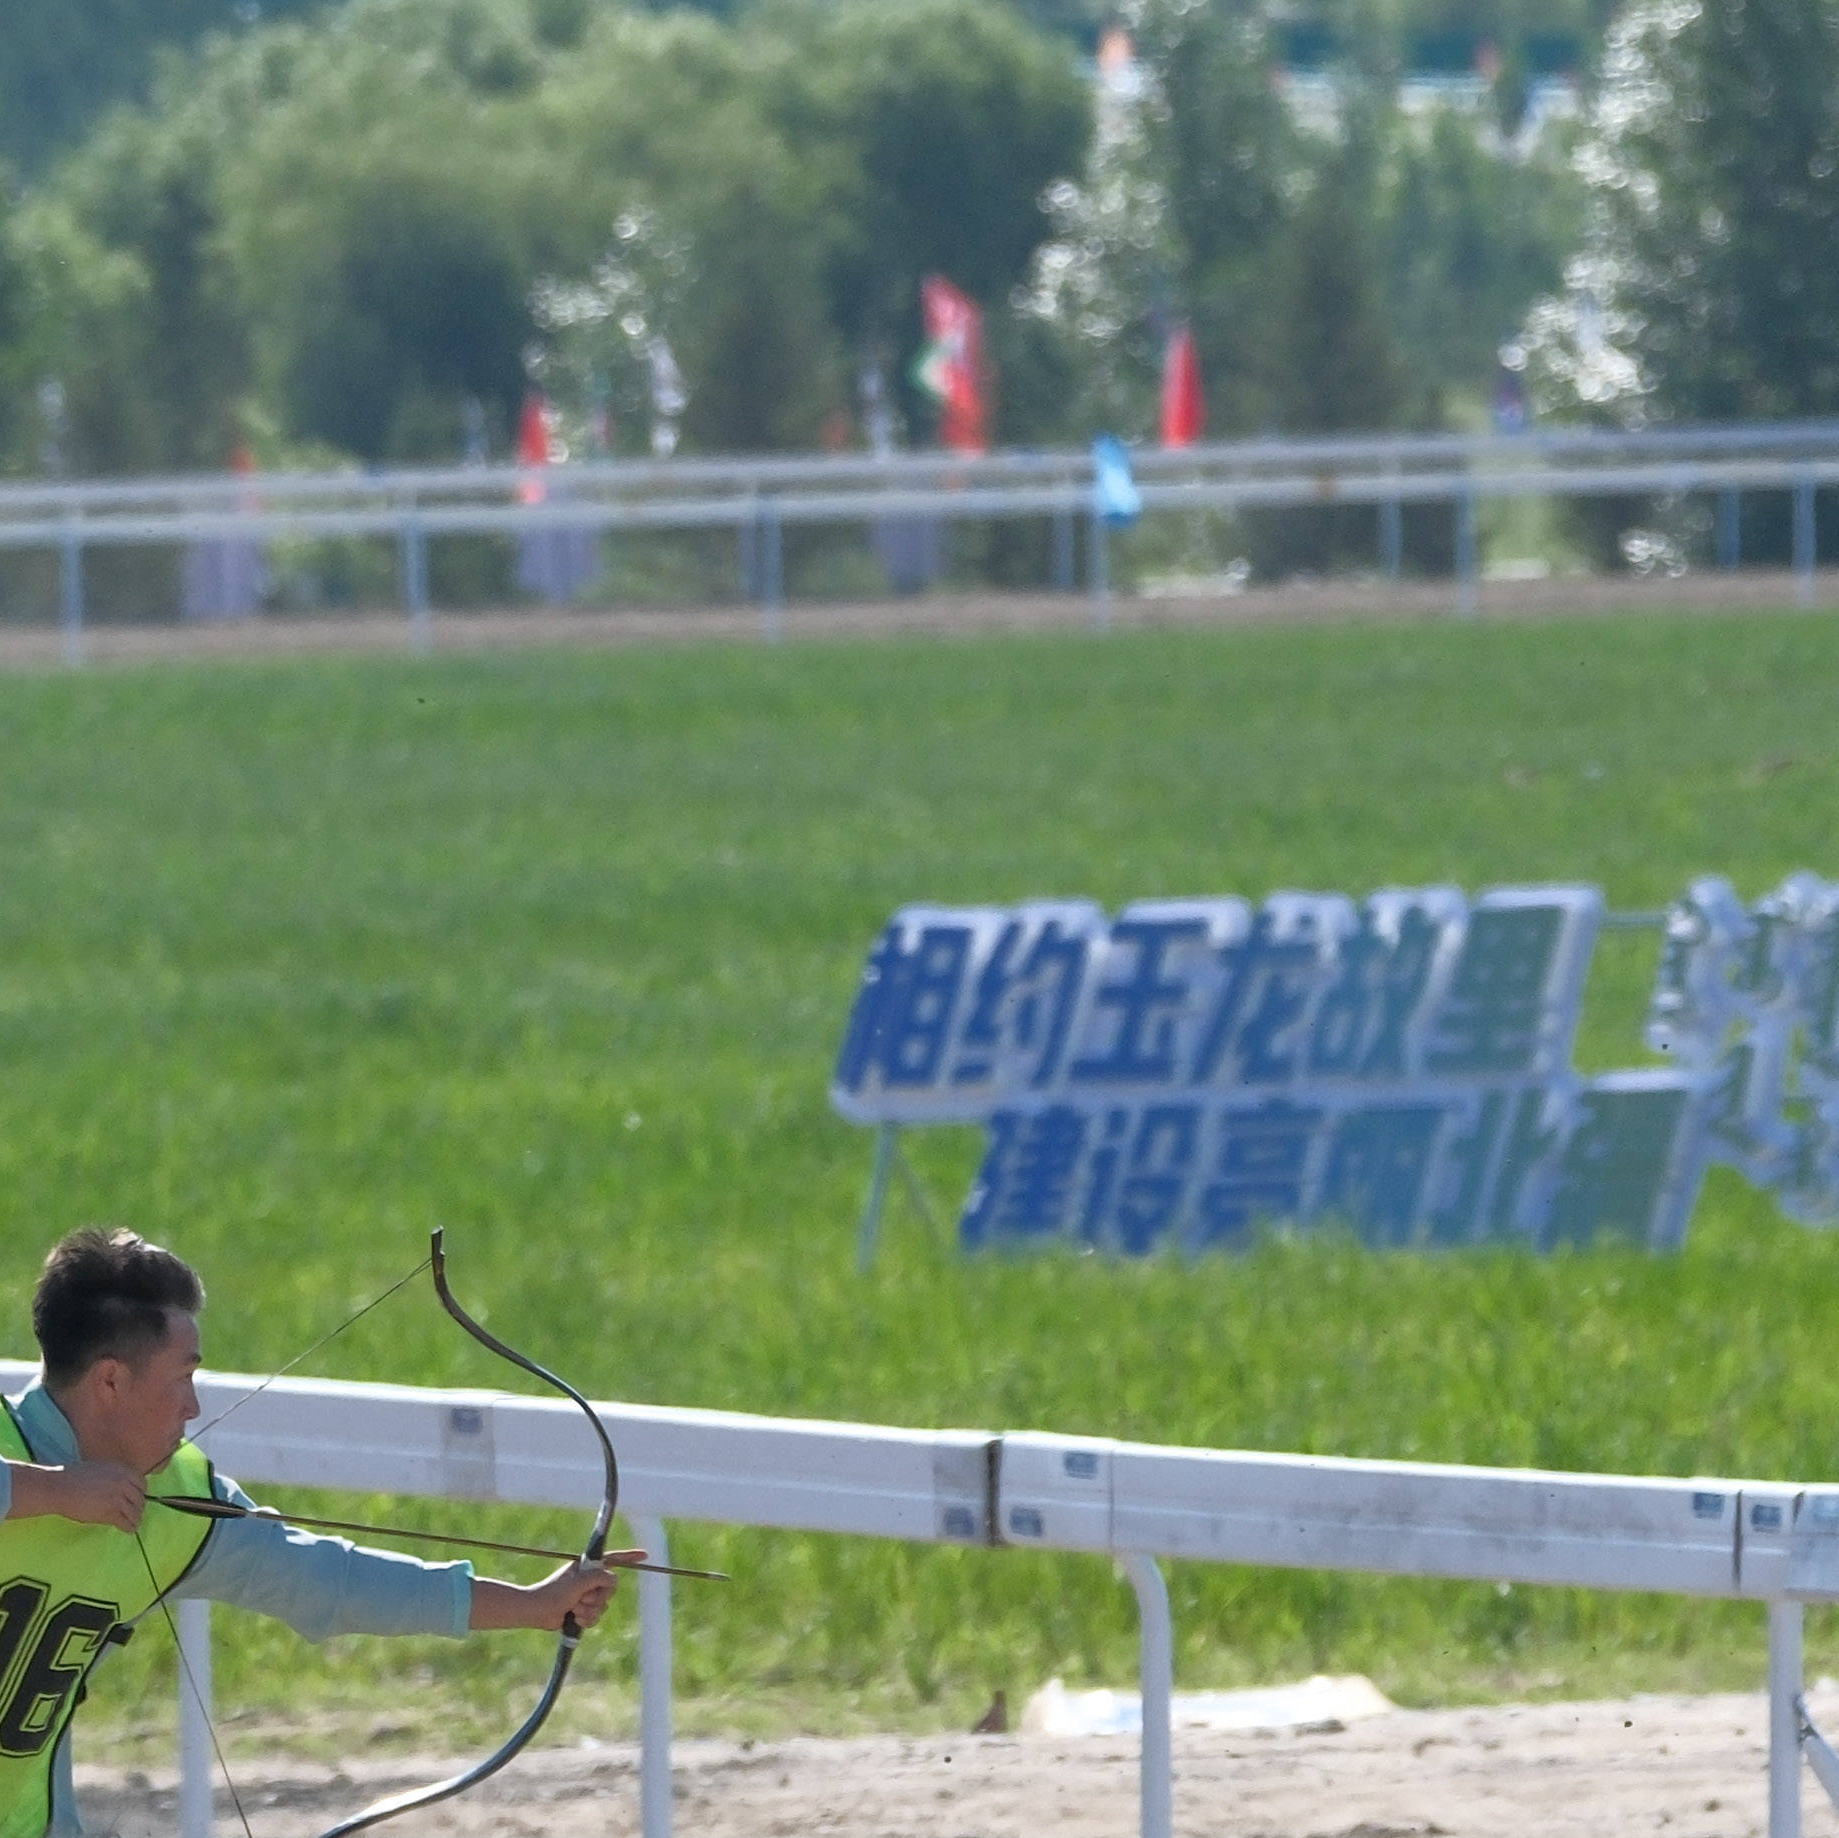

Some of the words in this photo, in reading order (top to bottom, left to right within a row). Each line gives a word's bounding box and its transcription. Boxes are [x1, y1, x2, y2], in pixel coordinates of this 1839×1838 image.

[834, 900, 1567, 1098] 相约玉龙故里
